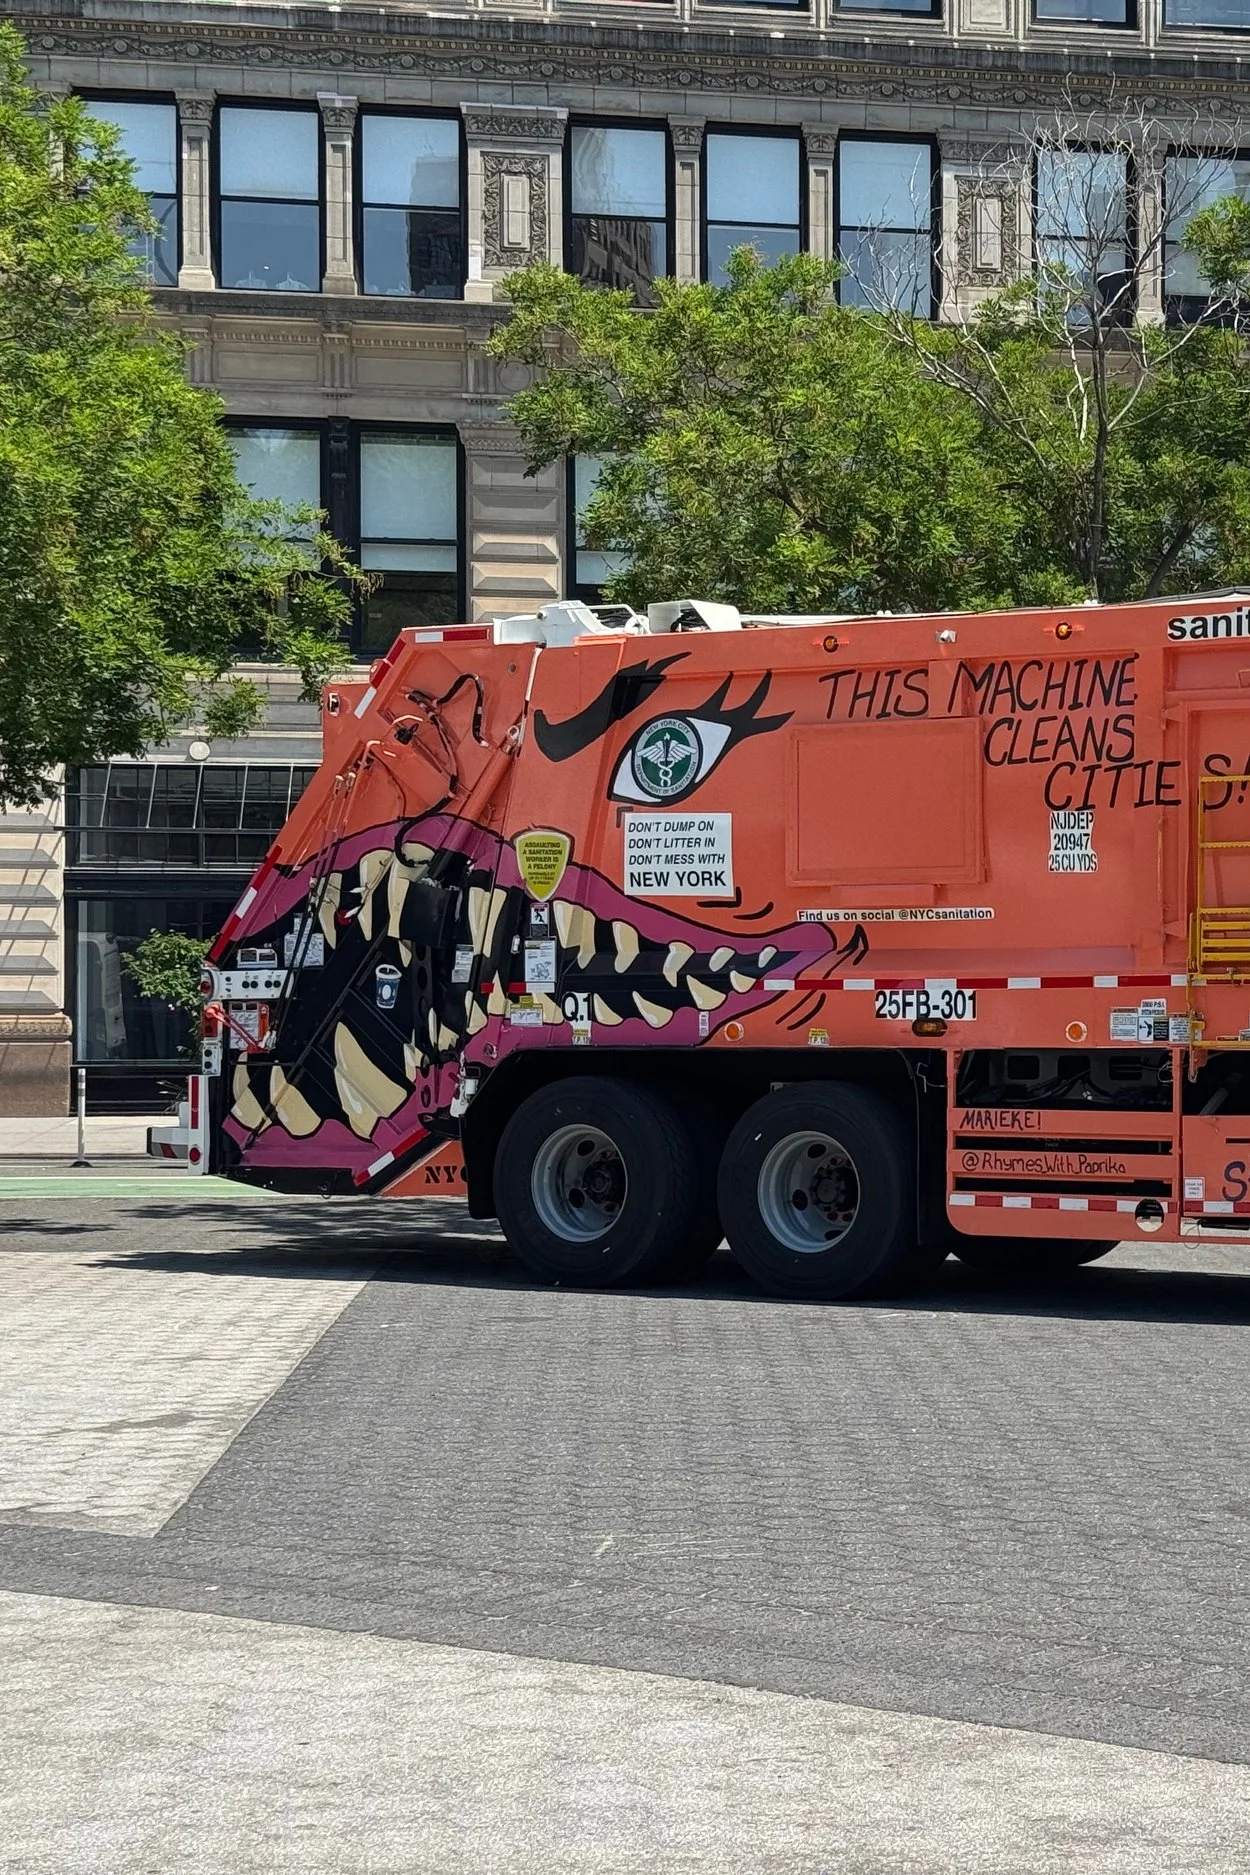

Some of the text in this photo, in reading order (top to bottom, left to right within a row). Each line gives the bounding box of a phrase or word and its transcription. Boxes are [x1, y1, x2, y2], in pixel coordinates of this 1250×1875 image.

[818, 652, 1140, 719] THIS MACHINE
[645, 719, 691, 736] NEW YORK CITY
[983, 714, 1135, 767] CLEANS
[628, 820, 715, 833] DON'T DUMP ON
[1051, 811, 1094, 830] NJDEP
[628, 837, 716, 849] DON'T LITTER IN
[1053, 833, 1090, 851] 20947
[629, 853, 726, 866] DON'T MESS WITH
[629, 870, 727, 888] NEW YORK
[798, 908, 992, 921] Find us on social @NYCsanitation
[561, 992, 592, 1022] Q.1
[875, 989, 977, 1019] 25FB-301
[959, 1109, 1042, 1131] MARIEKE!
[961, 1151, 1127, 1175] @Rhymes_With_Paprika
